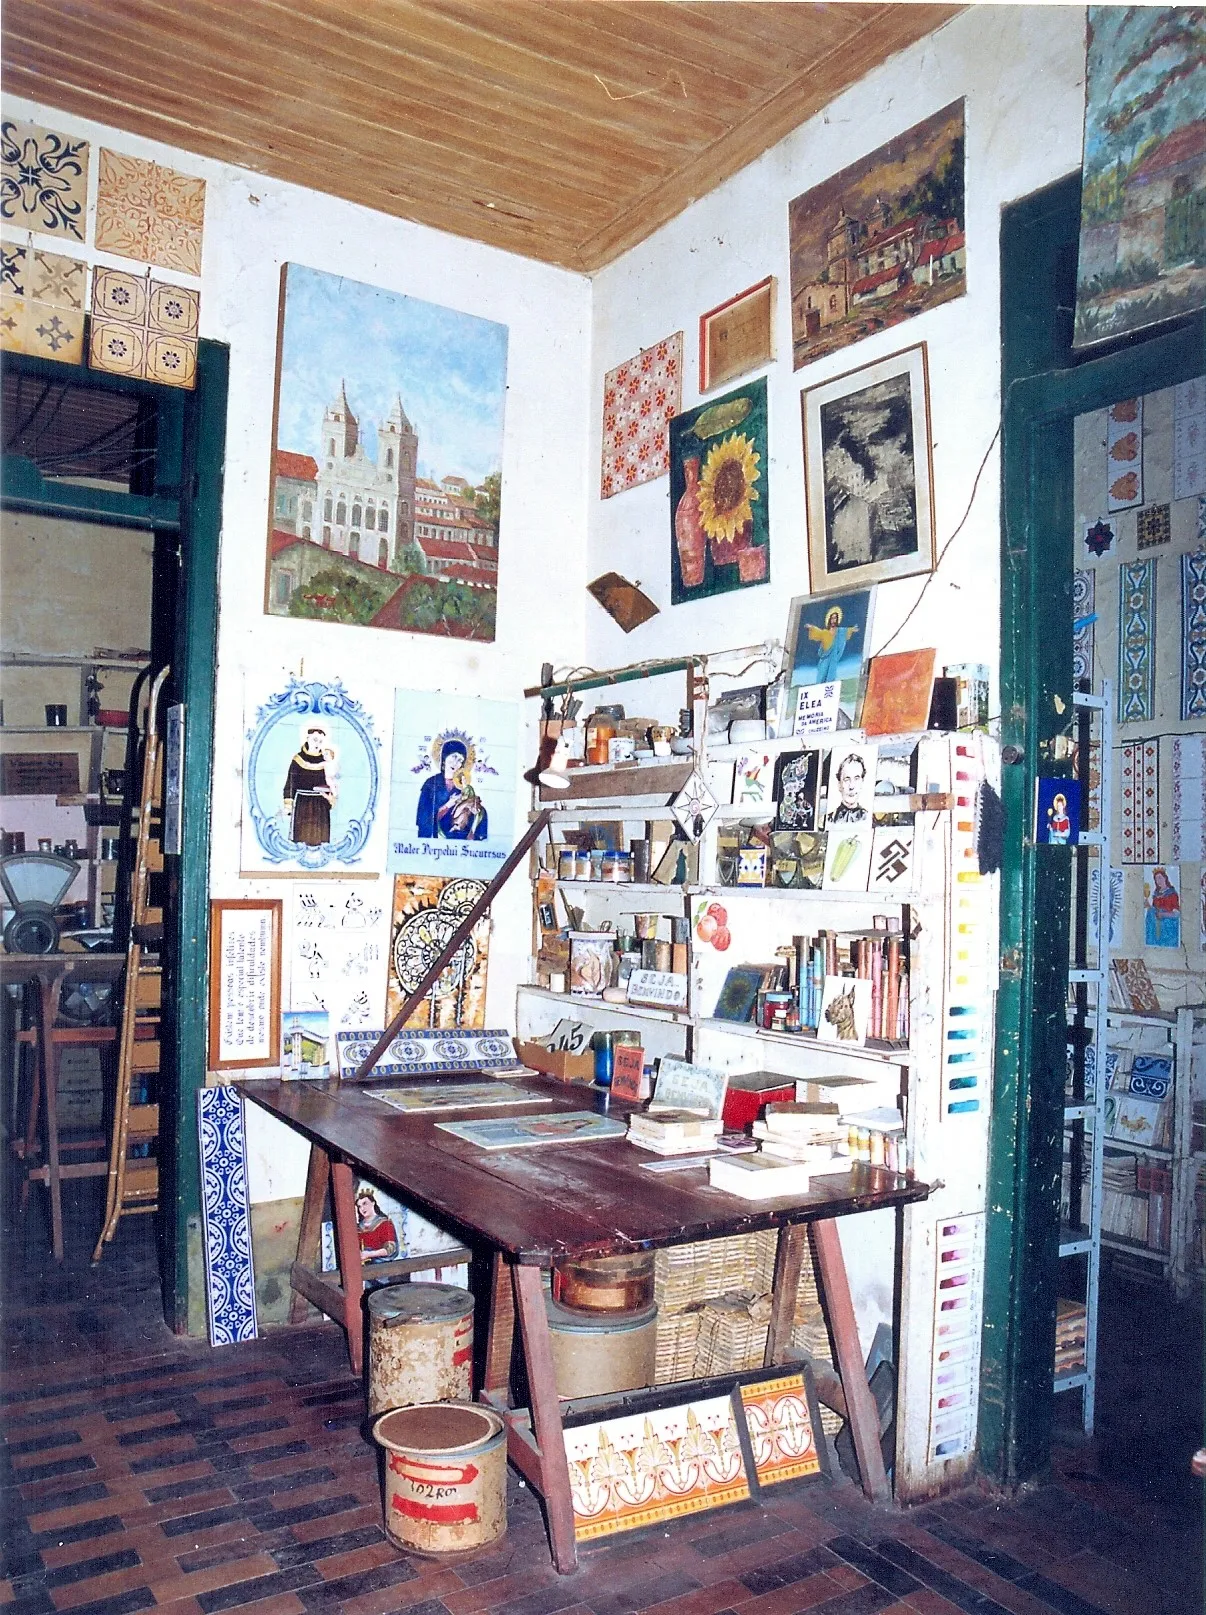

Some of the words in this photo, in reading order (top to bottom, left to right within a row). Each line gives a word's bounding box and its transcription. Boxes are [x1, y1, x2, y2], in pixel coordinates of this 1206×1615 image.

[800, 691, 809, 701] IX
[800, 699, 822, 710] ELEA
[394, 843, 420, 855] Mater
[422, 843, 458, 861] Perpetui
